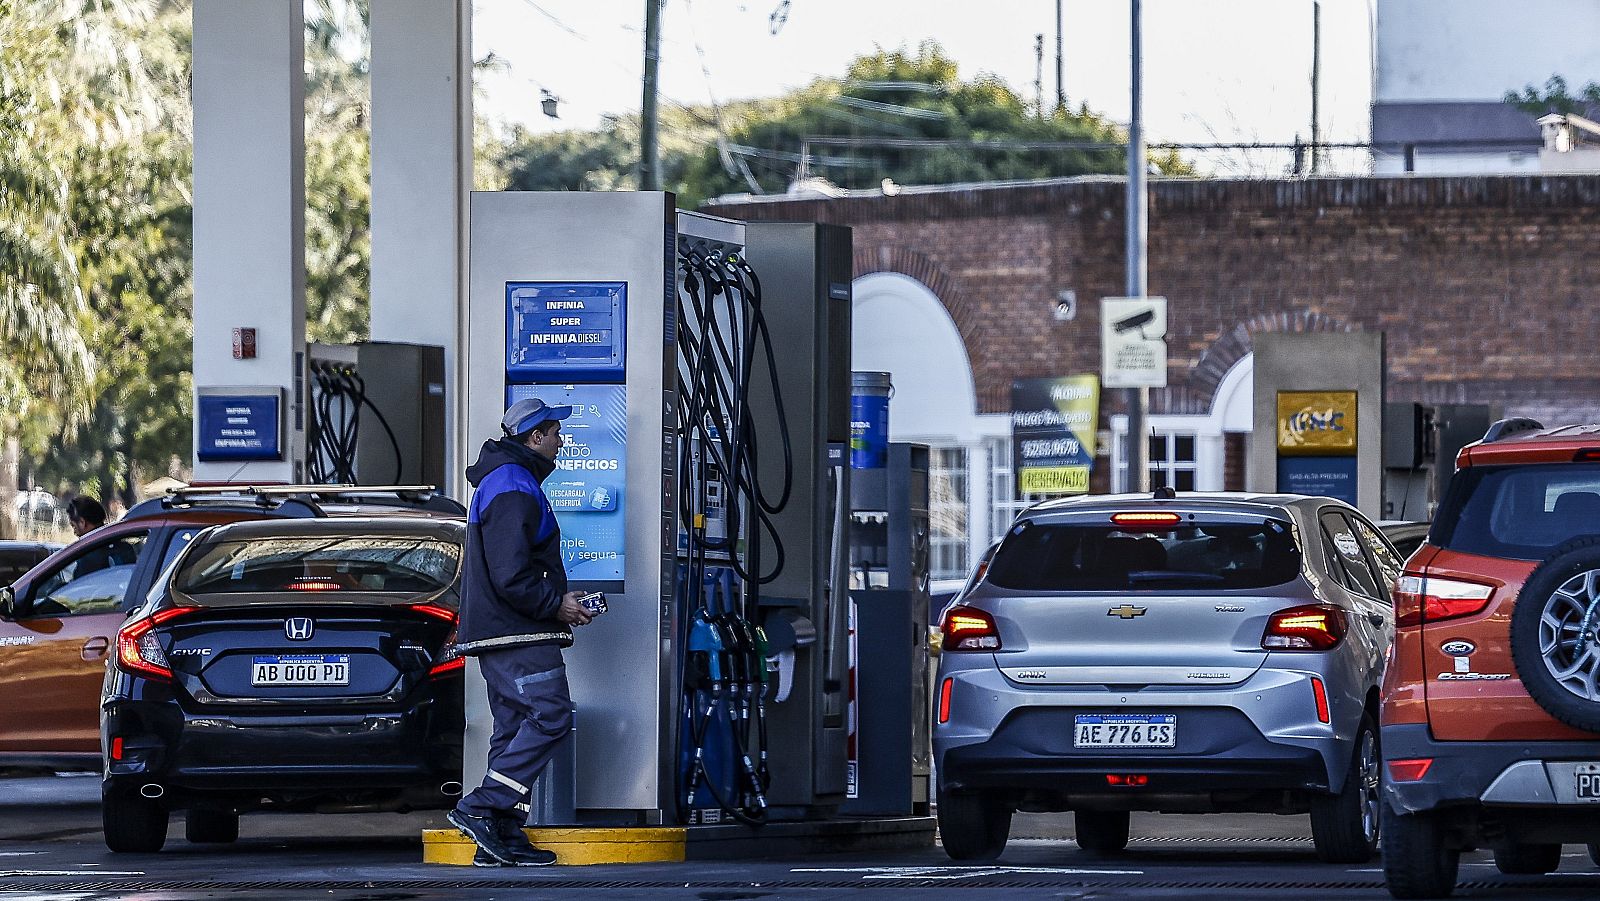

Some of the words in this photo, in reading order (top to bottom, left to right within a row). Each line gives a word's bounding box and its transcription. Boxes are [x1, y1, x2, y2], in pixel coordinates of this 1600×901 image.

[546, 301, 585, 310] INFINIA
[550, 317, 581, 326] SUPER
[530, 333, 577, 344] INFINIA
[578, 333, 601, 343] DIESEL
[554, 459, 618, 471] NEFICIOS
[550, 489, 586, 498] DESCARGALA
[551, 499, 555, 507] Y
[568, 551, 575, 562] y
[578, 551, 617, 562] segura
[170, 648, 212, 656] CIVIC
[257, 665, 278, 681] AB
[285, 665, 316, 681] 000
[323, 665, 345, 681] PD
[1017, 670, 1047, 679] ONIX
[1079, 725, 1102, 743] AE
[1108, 725, 1141, 743] 776
[1147, 725, 1170, 743] CS
